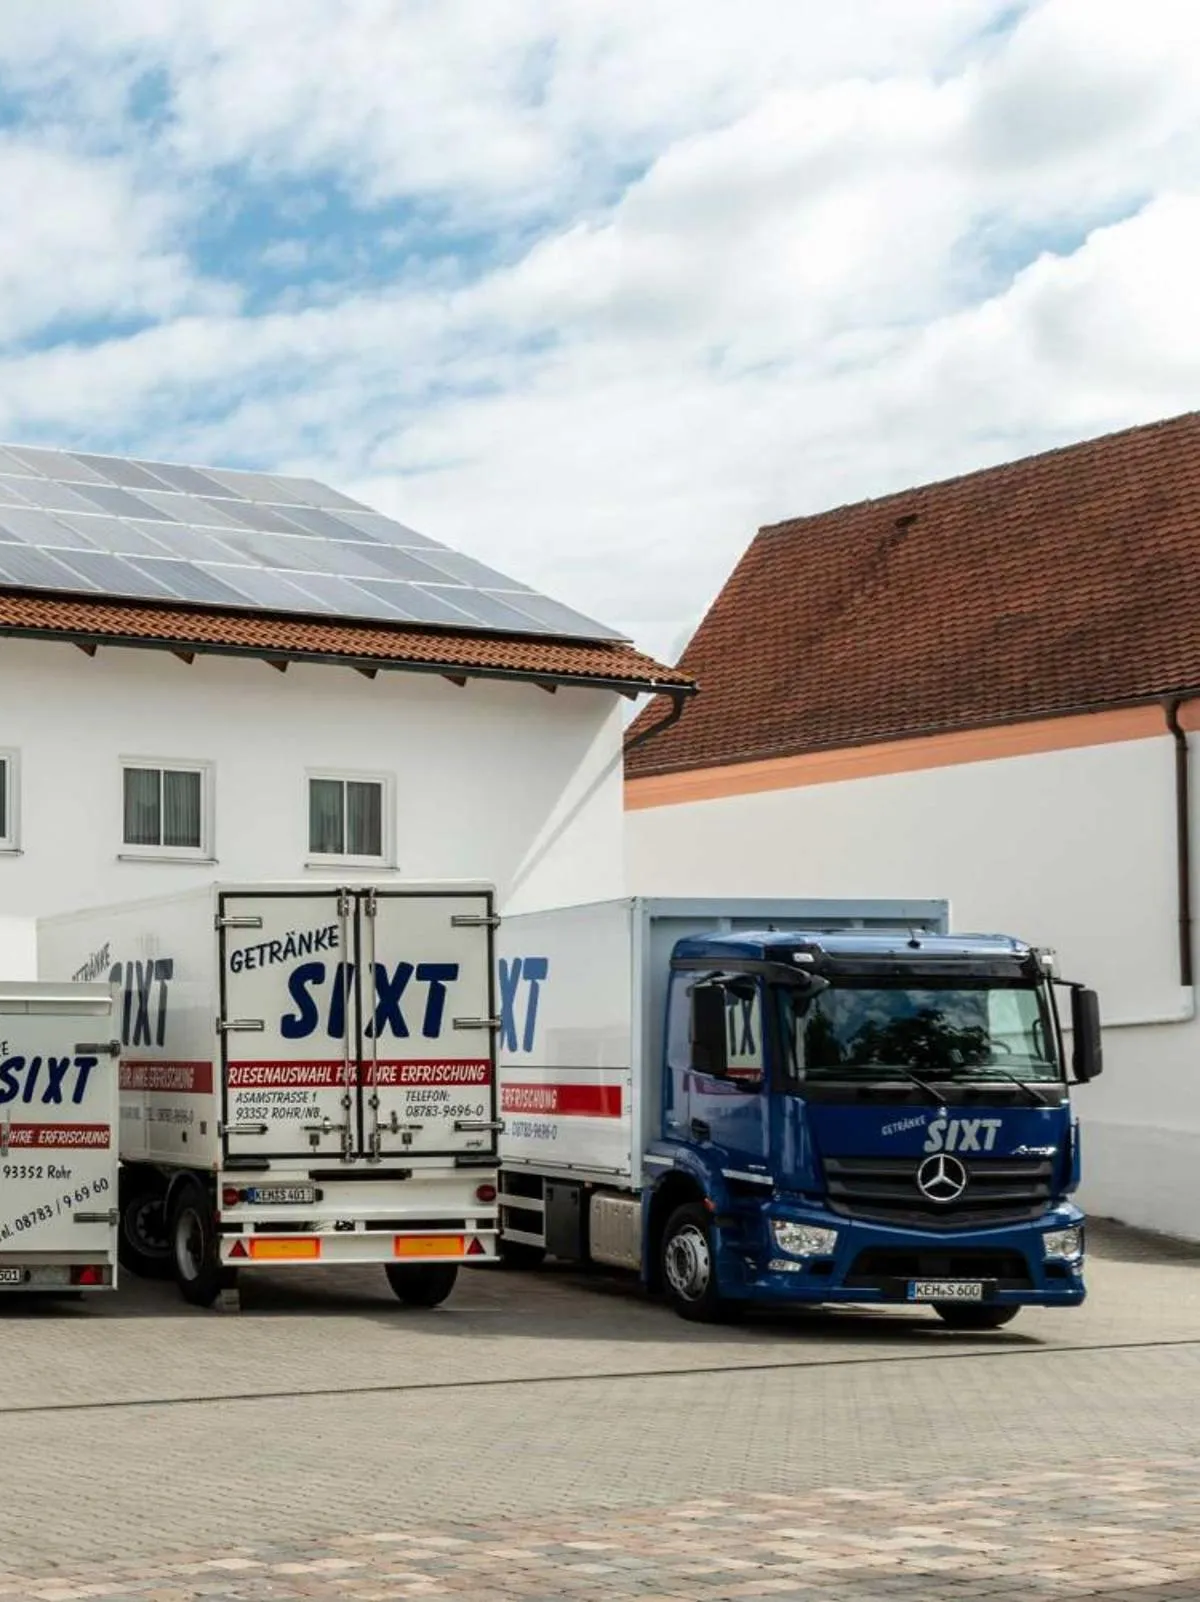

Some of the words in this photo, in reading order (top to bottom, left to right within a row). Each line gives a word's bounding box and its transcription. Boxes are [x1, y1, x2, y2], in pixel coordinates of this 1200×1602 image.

[230, 924, 339, 973] GETRÄNKE
[281, 961, 459, 1039] SIXT
[228, 1066, 332, 1084] RIESENAUSWAHL
[367, 1065, 397, 1083] IHRE
[400, 1064, 486, 1082] ERFRISCHUNG
[235, 1091, 309, 1103] ASAMSTRASSE
[312, 1091, 316, 1102] 1
[406, 1090, 451, 1102] TELEFON:
[236, 1107, 268, 1120] 93352
[405, 1104, 484, 1118] 08783-9696-0
[881, 1114, 926, 1136] GETRÄNKE
[38, 1130, 110, 1144] ERFRISCHUNG
[923, 1119, 1002, 1153] SIXT
[3, 1165, 44, 1179] 93352
[47, 1164, 72, 1179] Rohr
[15, 1204, 53, 1231] 08783
[63, 1195, 72, 1208] 9
[74, 1185, 90, 1202] 69
[93, 1177, 109, 1193] 60
